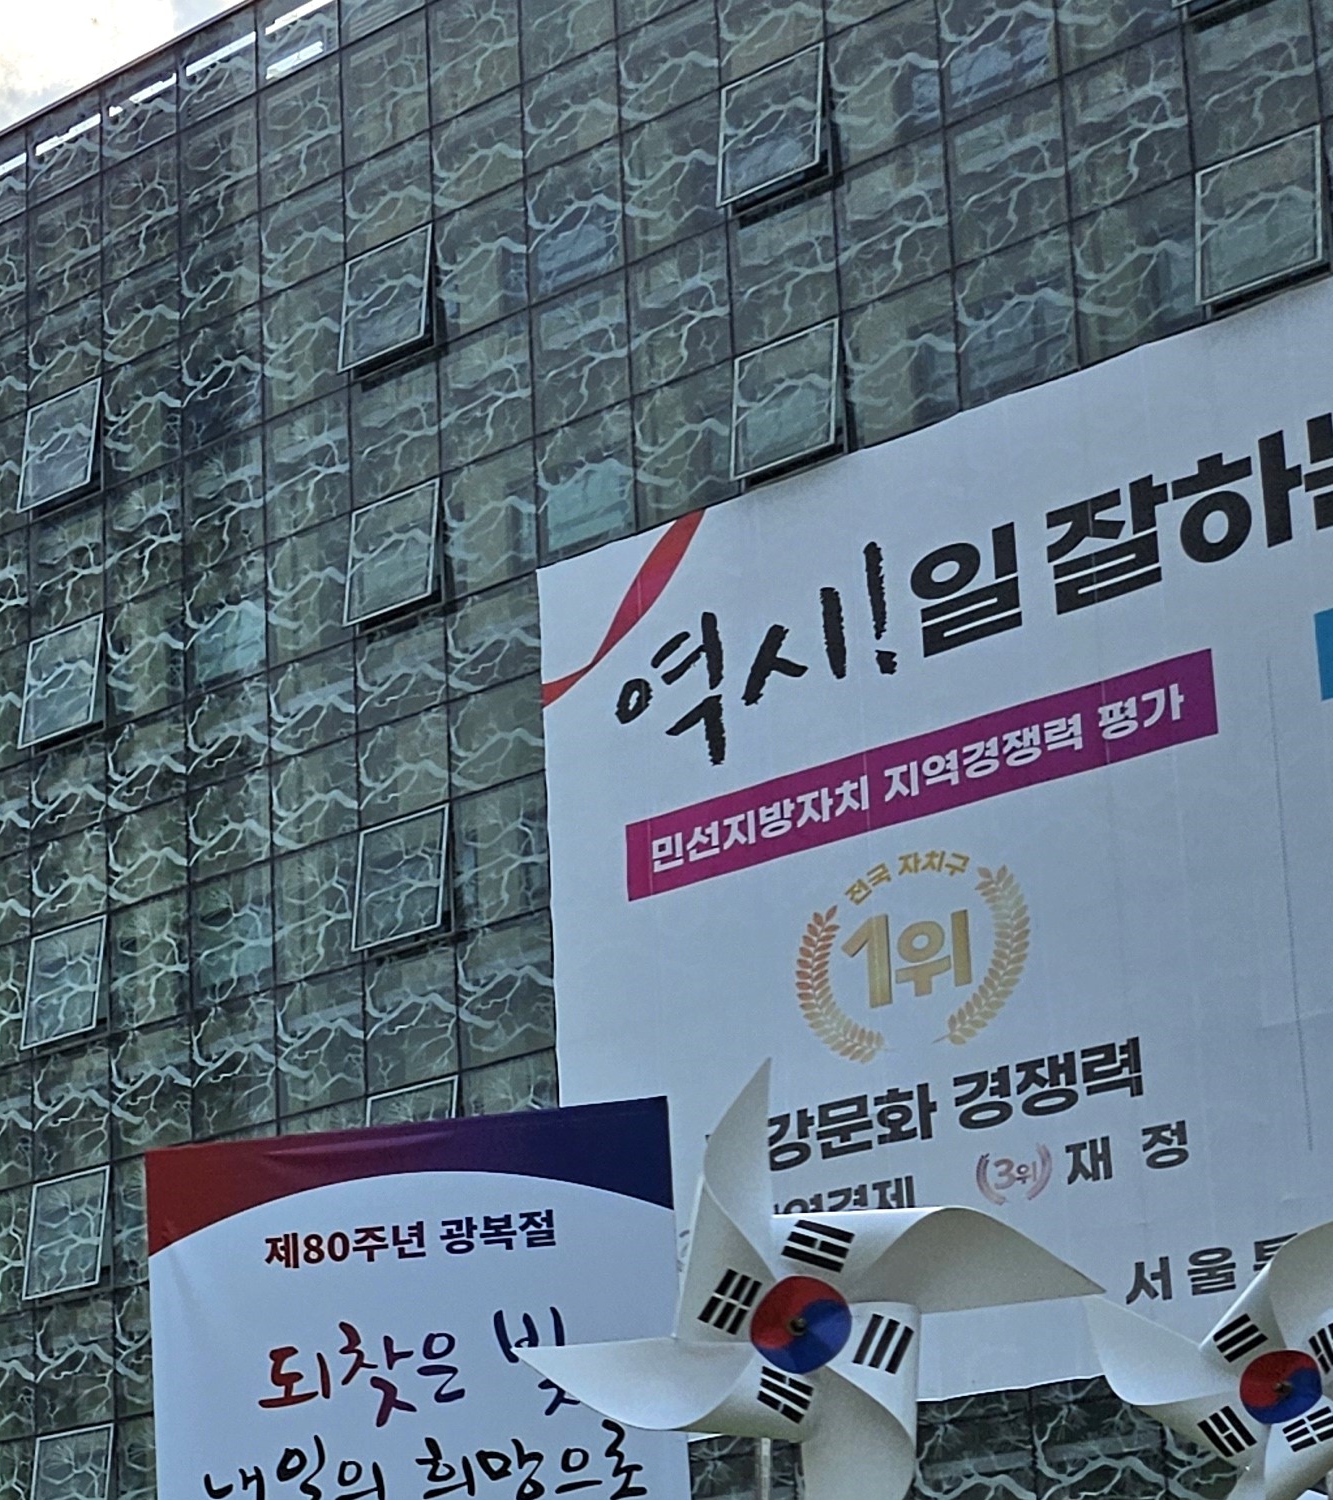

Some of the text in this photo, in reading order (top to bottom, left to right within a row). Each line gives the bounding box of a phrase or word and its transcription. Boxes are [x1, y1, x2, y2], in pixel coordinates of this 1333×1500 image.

[614, 541, 898, 767] 역시!
[1045, 412, 1333, 616] 잘하
[650, 683, 1184, 873] 민선지방자치 지역경쟁력 평가
[844, 850, 971, 906] 전국 자치구
[840, 908, 973, 1009] 1위
[767, 1036, 1144, 1173] 강문화 경쟁력
[263, 1208, 558, 1269] 제80주년 광복절
[257, 1320, 467, 1428] 되찾은
